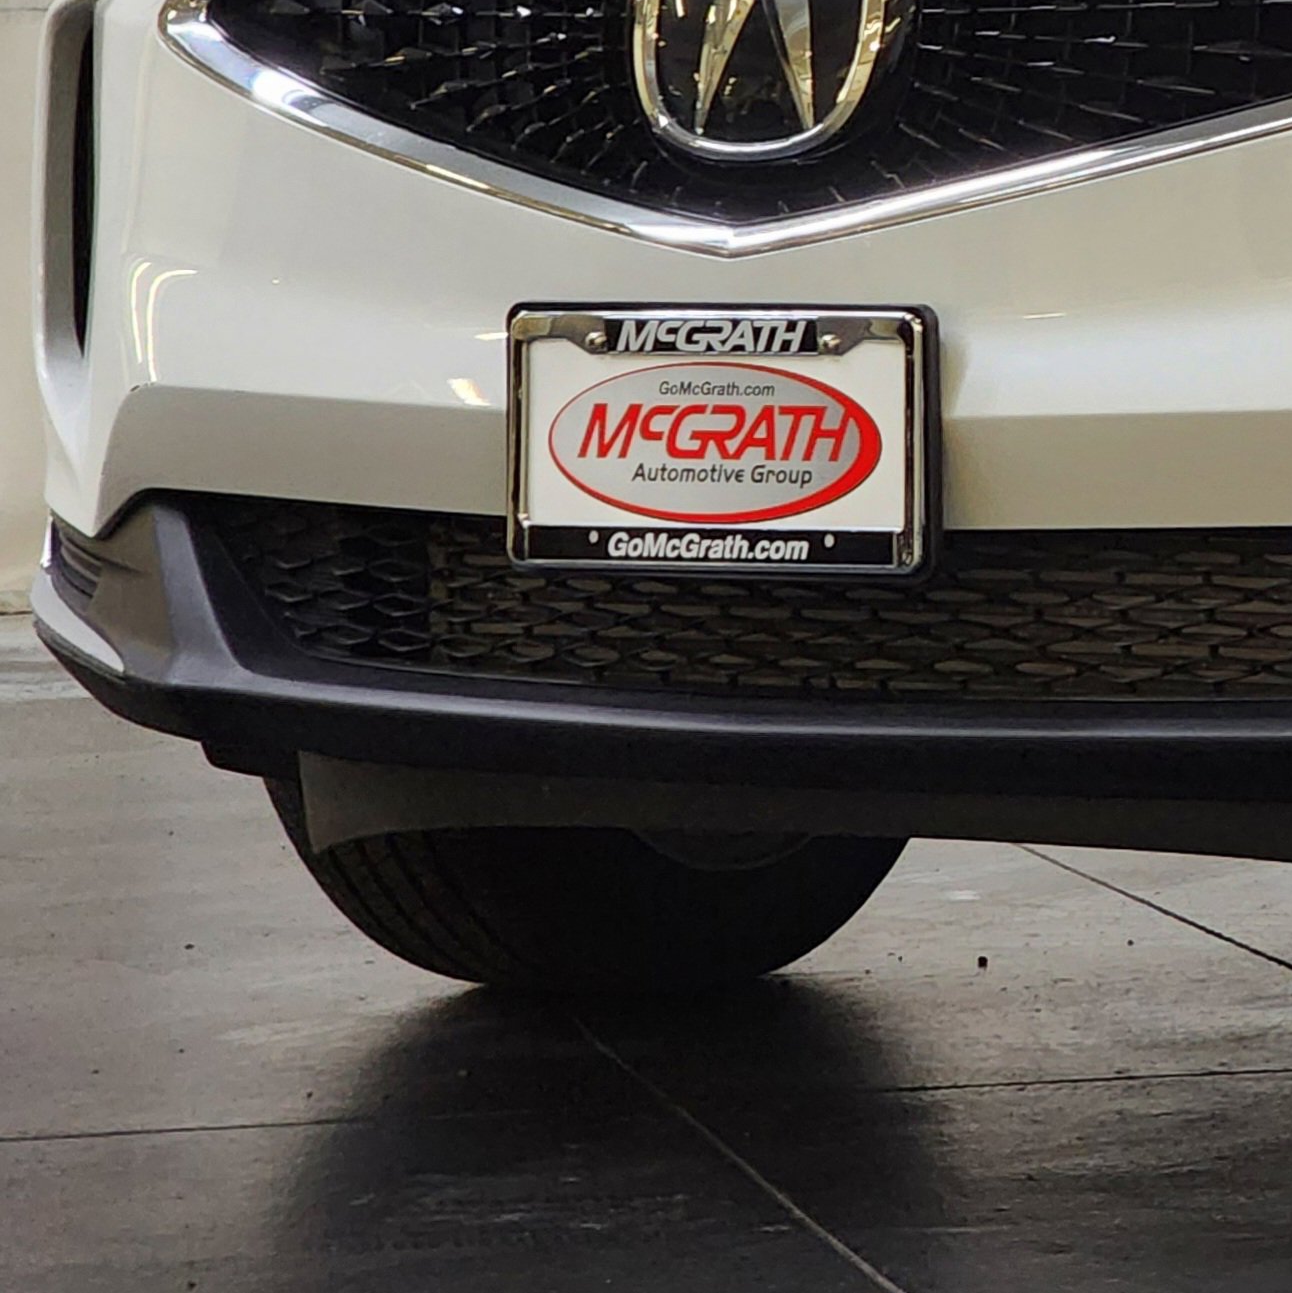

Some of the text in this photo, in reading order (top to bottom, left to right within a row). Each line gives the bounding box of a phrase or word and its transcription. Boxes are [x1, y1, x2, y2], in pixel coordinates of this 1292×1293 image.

[659, 381, 775, 398] GoMcGrath.com
[631, 463, 813, 489] Automotive Group
[607, 531, 810, 562] GoMcGrath.com
